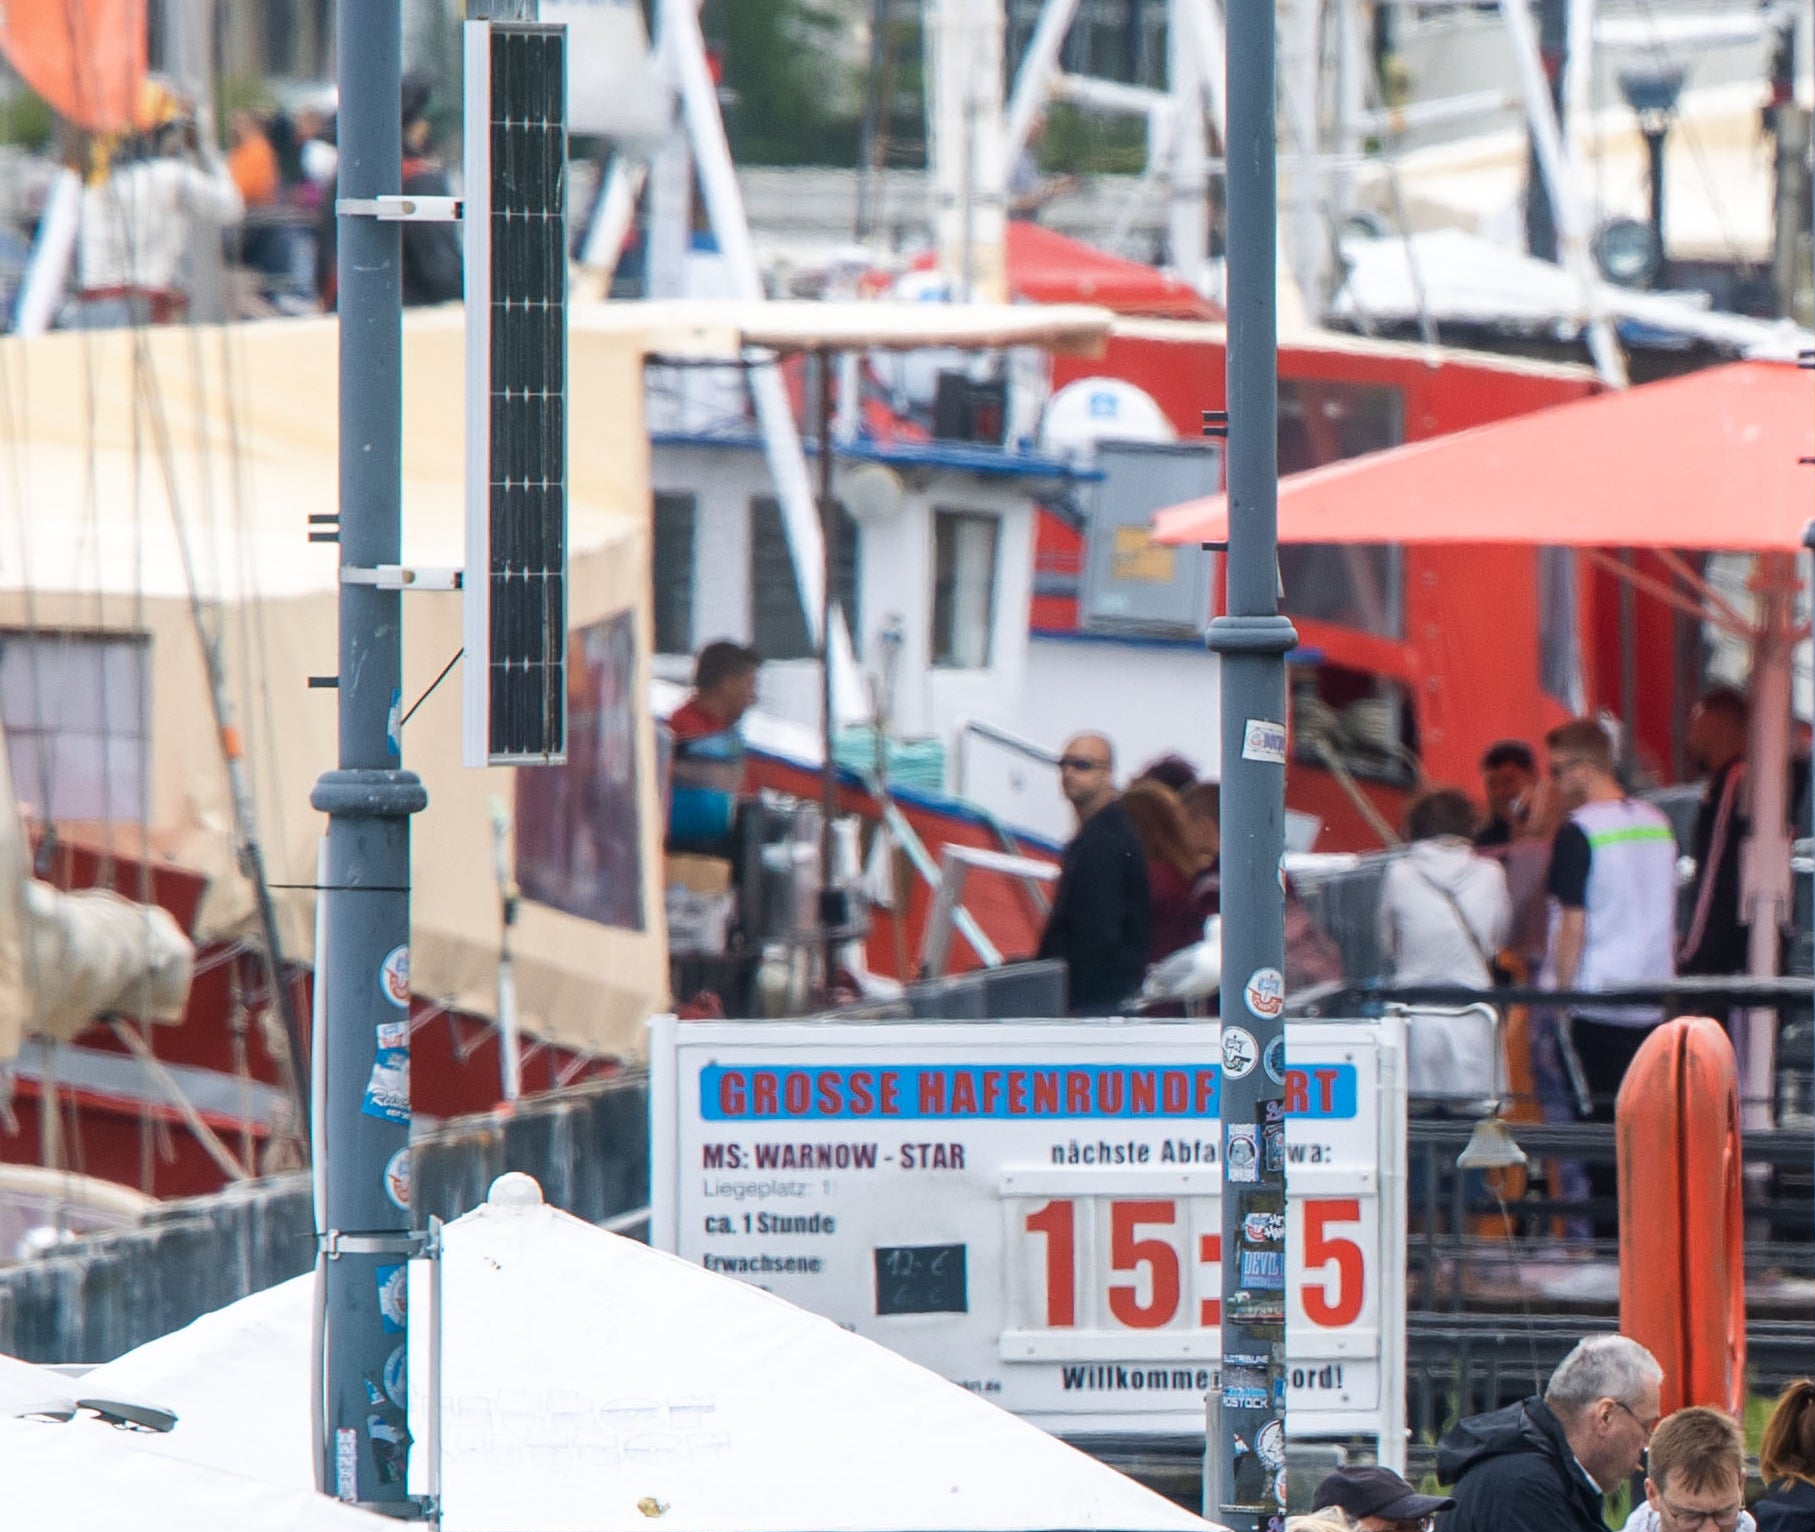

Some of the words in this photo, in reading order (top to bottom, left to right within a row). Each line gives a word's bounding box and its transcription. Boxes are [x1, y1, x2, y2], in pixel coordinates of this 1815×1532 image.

[719, 1070, 900, 1115] GROSSE
[918, 1069, 1338, 1115] HAFENRUNDFRT
[702, 1143, 749, 1170] MS:
[755, 1143, 878, 1170] WARNOW
[901, 1143, 966, 1170] STAR
[1051, 1138, 1150, 1165] nächste
[1160, 1138, 1223, 1166] Abfa
[1286, 1142, 1333, 1165] wa:
[705, 1214, 737, 1236] ca.
[757, 1210, 836, 1236] Stunde
[1024, 1198, 1365, 1330] 15:5
[1289, 1363, 1345, 1390] ord!
